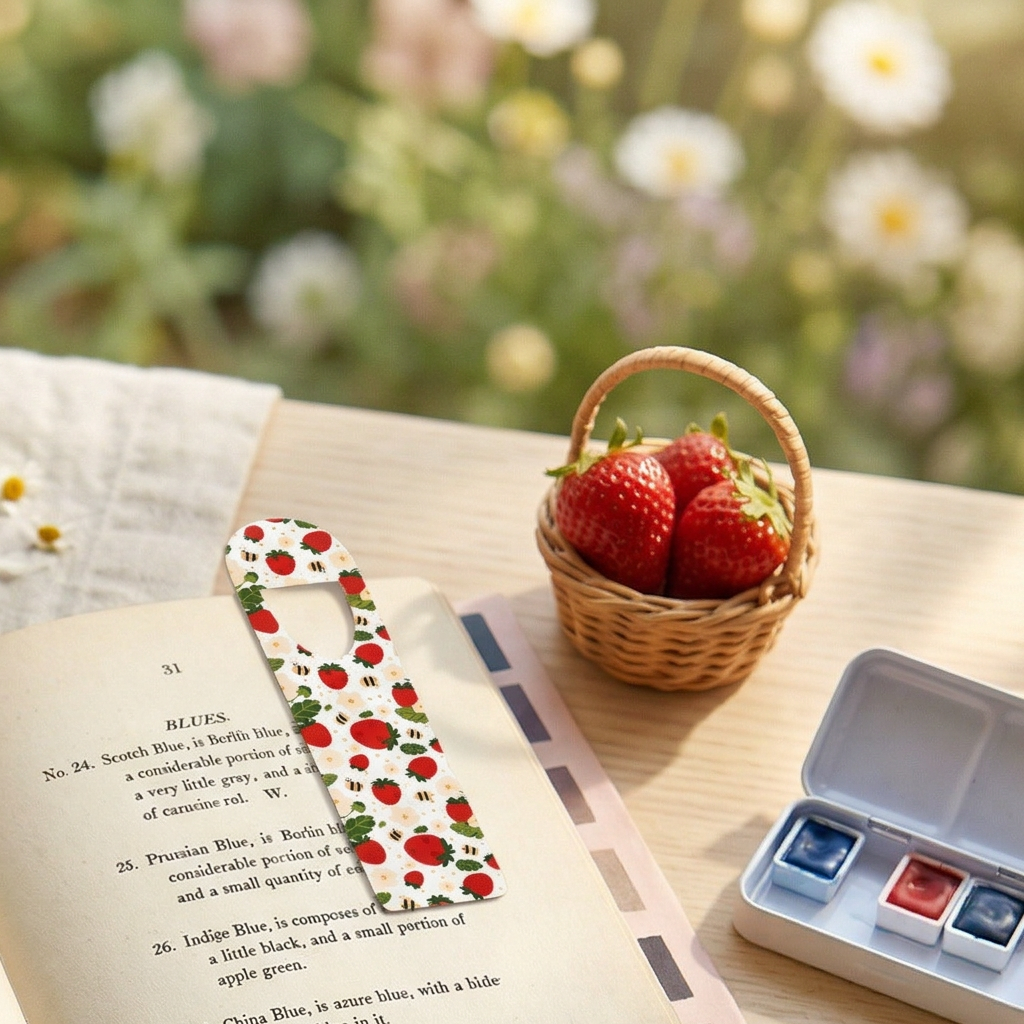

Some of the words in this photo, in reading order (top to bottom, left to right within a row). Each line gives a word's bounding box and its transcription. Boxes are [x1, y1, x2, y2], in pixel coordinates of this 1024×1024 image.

[161, 663, 182, 676] 31
[165, 711, 231, 731] BLUES.
[42, 769, 69, 782] No.
[71, 760, 95, 774] 24.
[101, 746, 149, 766] Scotch
[152, 740, 190, 756] Blue,
[193, 736, 205, 748] is
[125, 772, 134, 782] a
[138, 756, 222, 779] considerable
[227, 747, 275, 768] portion
[278, 743, 292, 756] of
[135, 791, 144, 801] a
[147, 784, 178, 798] very
[183, 775, 217, 792] little
[263, 766, 288, 779] and
[293, 767, 302, 776] a
[143, 807, 158, 822] of
[262, 787, 288, 799] W.
[116, 860, 139, 874] 25.
[213, 837, 255, 852] Blue,
[260, 832, 273, 844] is
[168, 859, 257, 884] considerable
[317, 845, 331, 857] of
[177, 887, 205, 904] and
[210, 888, 219, 897] a
[223, 876, 261, 895] small
[265, 868, 322, 891] quantity
[327, 864, 342, 877] of
[151, 941, 176, 956] 26.
[233, 922, 273, 938] Blue,
[276, 916, 288, 930] is
[291, 909, 359, 927] composes
[362, 902, 376, 916] of
[208, 955, 218, 965] a
[222, 945, 257, 963] little
[262, 937, 306, 955] black,
[310, 930, 338, 946] and
[342, 931, 351, 941] a
[355, 922, 393, 939] small
[397, 917, 449, 936] portion
[451, 913, 466, 926] of
[217, 968, 258, 988] apple
[262, 961, 308, 980] green.
[270, 1005, 312, 1023] Blue,
[316, 999, 329, 1013] is
[334, 994, 373, 1010] azure
[375, 986, 414, 1003] blue,
[418, 980, 450, 997] with
[453, 981, 463, 992] a
